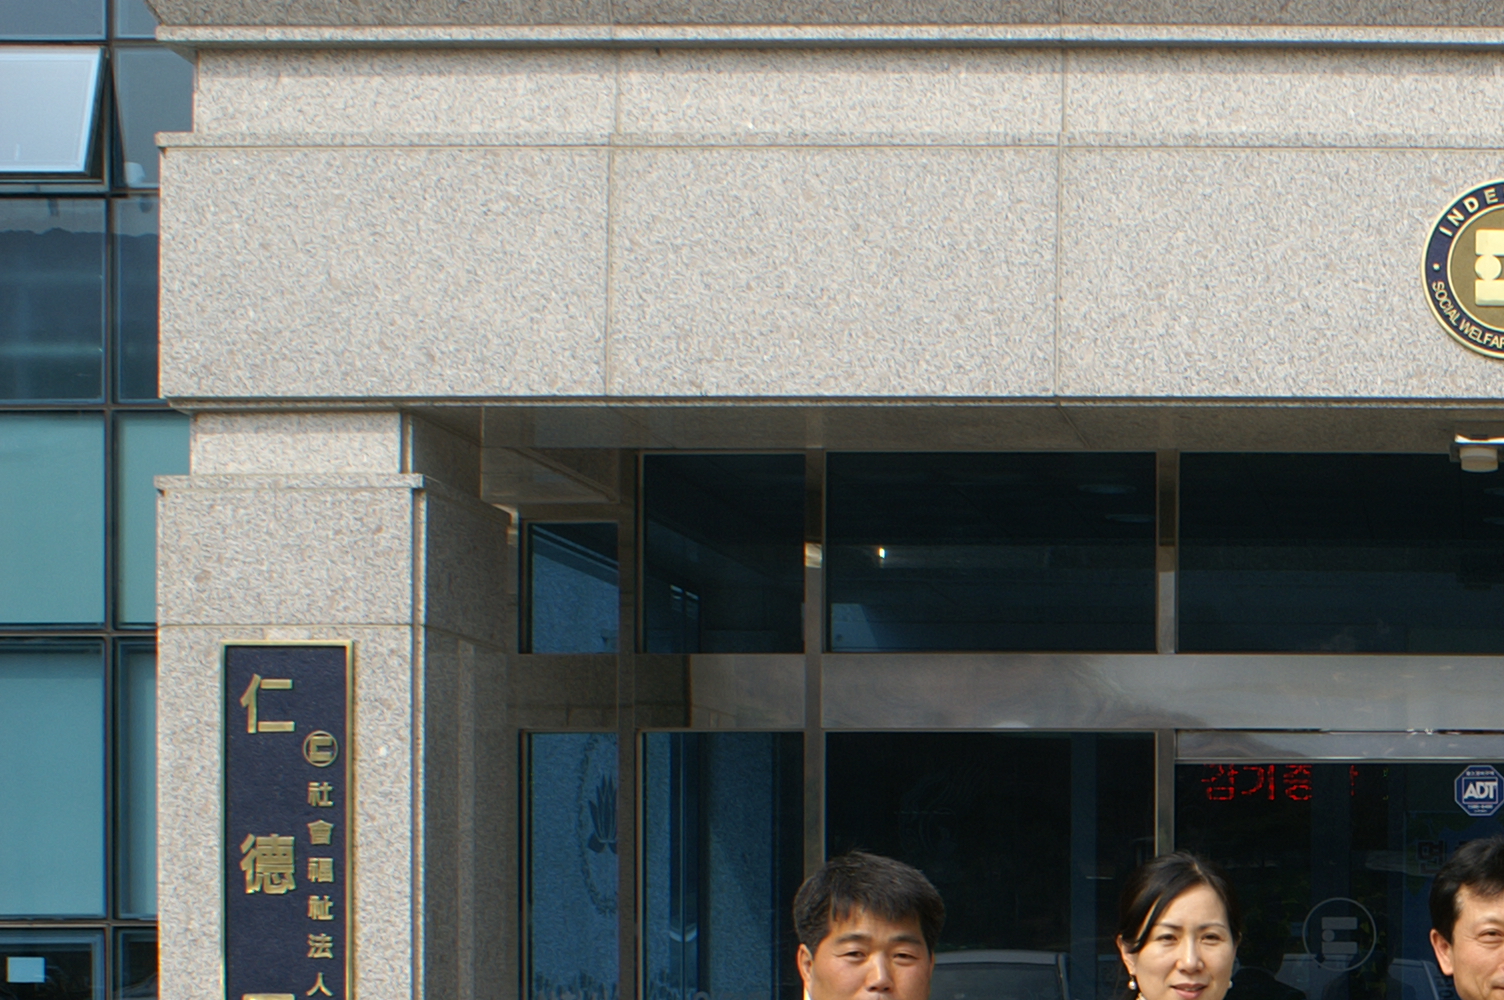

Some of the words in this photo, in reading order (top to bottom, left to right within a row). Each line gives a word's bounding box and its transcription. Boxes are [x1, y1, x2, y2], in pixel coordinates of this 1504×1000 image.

[1432, 280, 1458, 326] SOCIAL
[1464, 781, 1498, 799] ADT
[306, 781, 335, 998] 社會福祉法人
